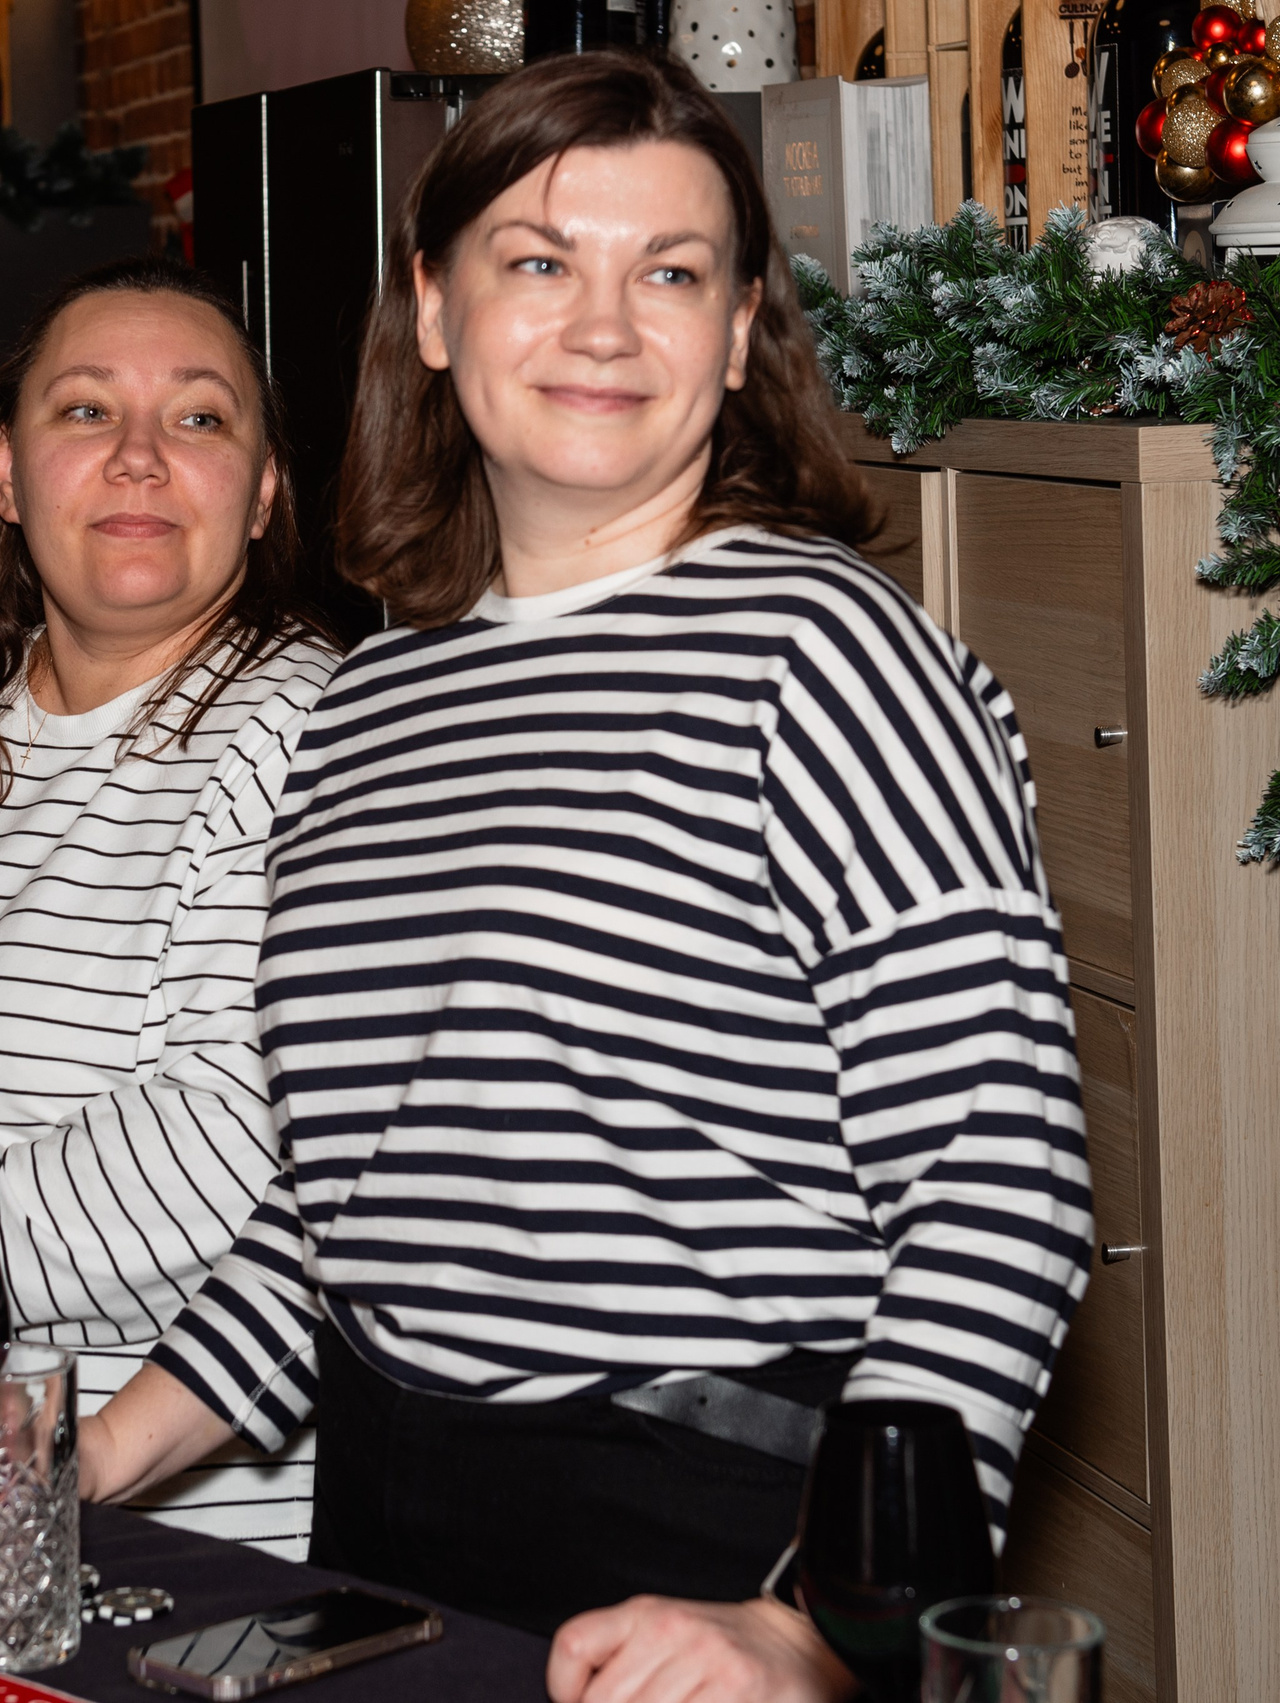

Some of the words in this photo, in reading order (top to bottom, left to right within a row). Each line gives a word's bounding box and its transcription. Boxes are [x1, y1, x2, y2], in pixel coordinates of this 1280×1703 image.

[1058, 3, 1104, 13] CULINA
[1069, 149, 1082, 159] to
[1062, 163, 1082, 174] but
